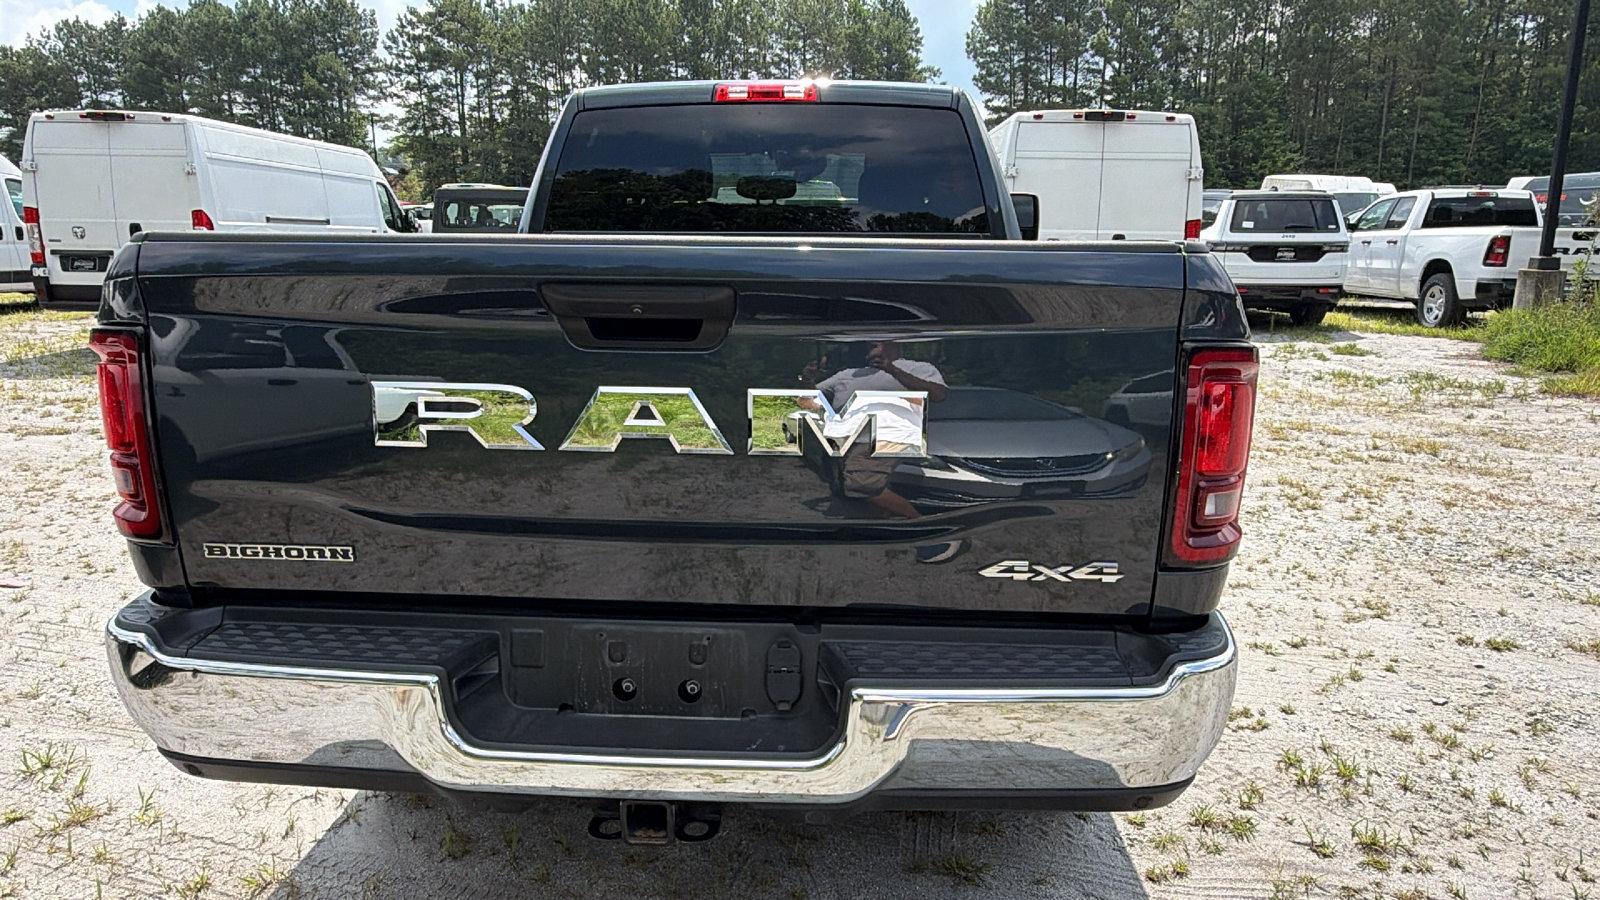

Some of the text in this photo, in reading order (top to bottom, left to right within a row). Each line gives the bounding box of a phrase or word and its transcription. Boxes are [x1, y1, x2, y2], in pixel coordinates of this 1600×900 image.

[1552, 247, 1600, 256] RA
[370, 381, 929, 458] RAM
[202, 542, 355, 562] BIGHORN
